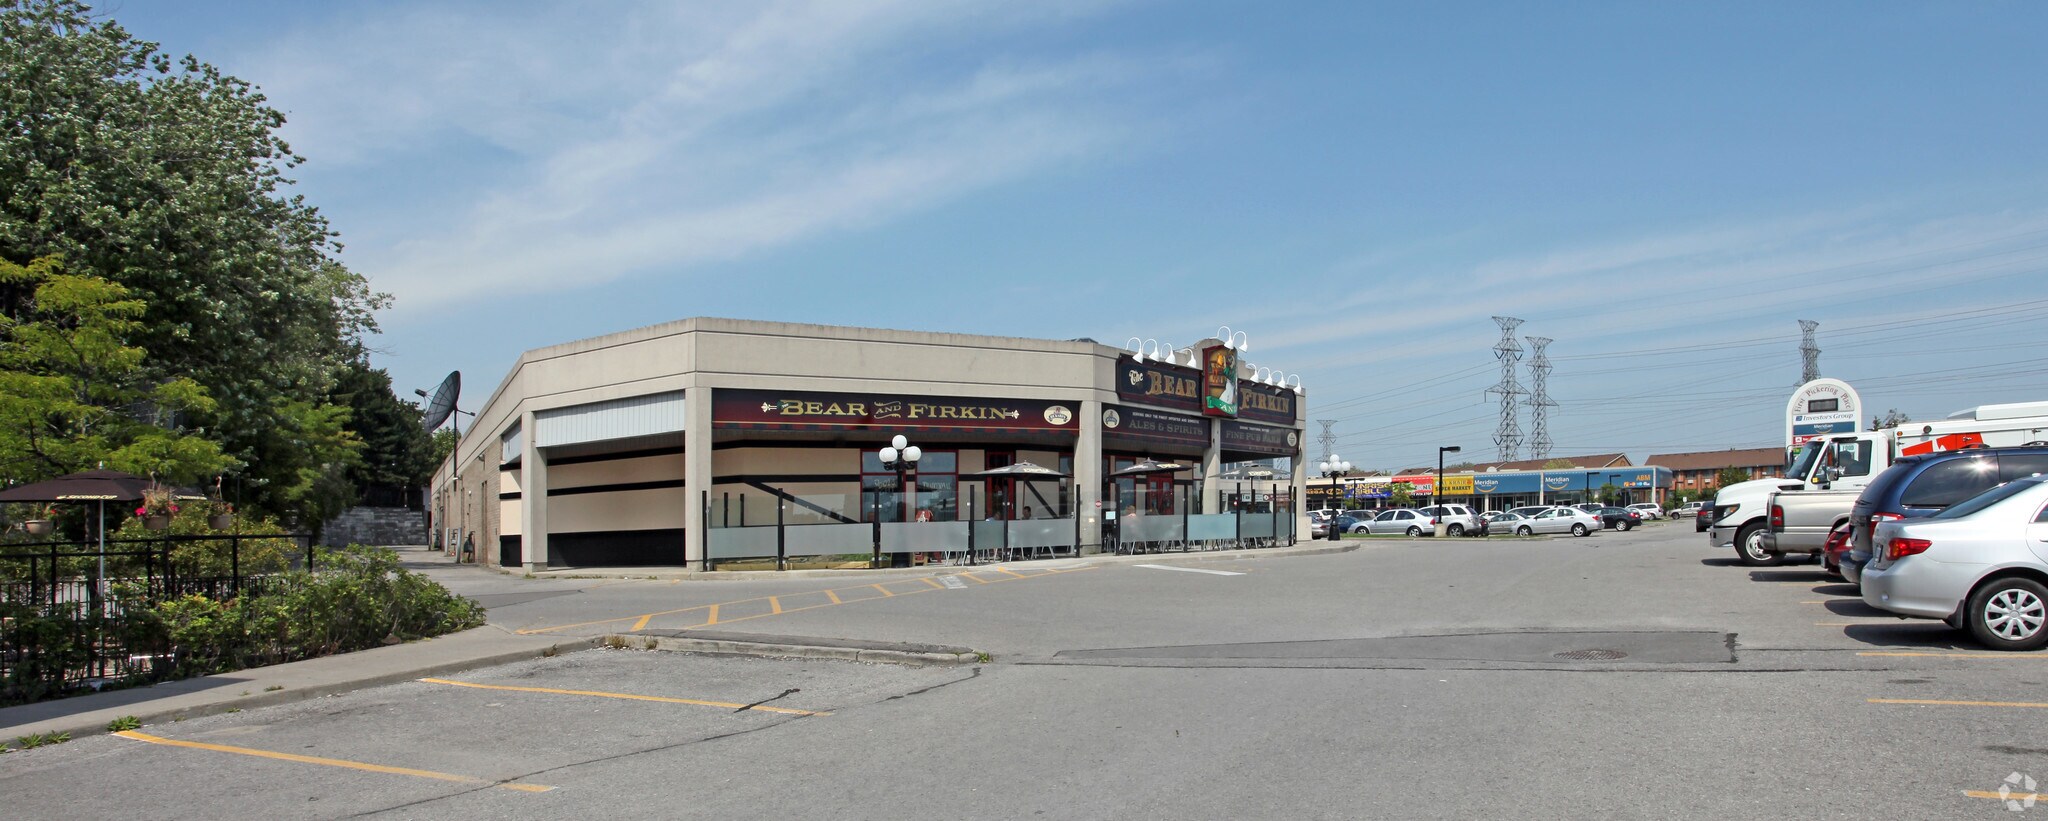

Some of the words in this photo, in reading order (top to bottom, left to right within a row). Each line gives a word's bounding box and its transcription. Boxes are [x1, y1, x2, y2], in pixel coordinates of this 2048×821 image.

[1129, 369, 1144, 385] The
[1146, 371, 1197, 398] BEAR
[780, 399, 869, 416] BEAR
[875, 404, 902, 415] AND
[907, 403, 1007, 420] FIRKIN
[1239, 388, 1290, 413] FIRKIN
[1795, 398, 1806, 412] First
[1806, 386, 1838, 396] Pickering
[1840, 392, 1851, 409] Place
[1128, 420, 1155, 430] ALES
[1167, 424, 1204, 435] SPIRITS
[1226, 430, 1245, 440] FINE
[1246, 433, 1261, 442] PUB
